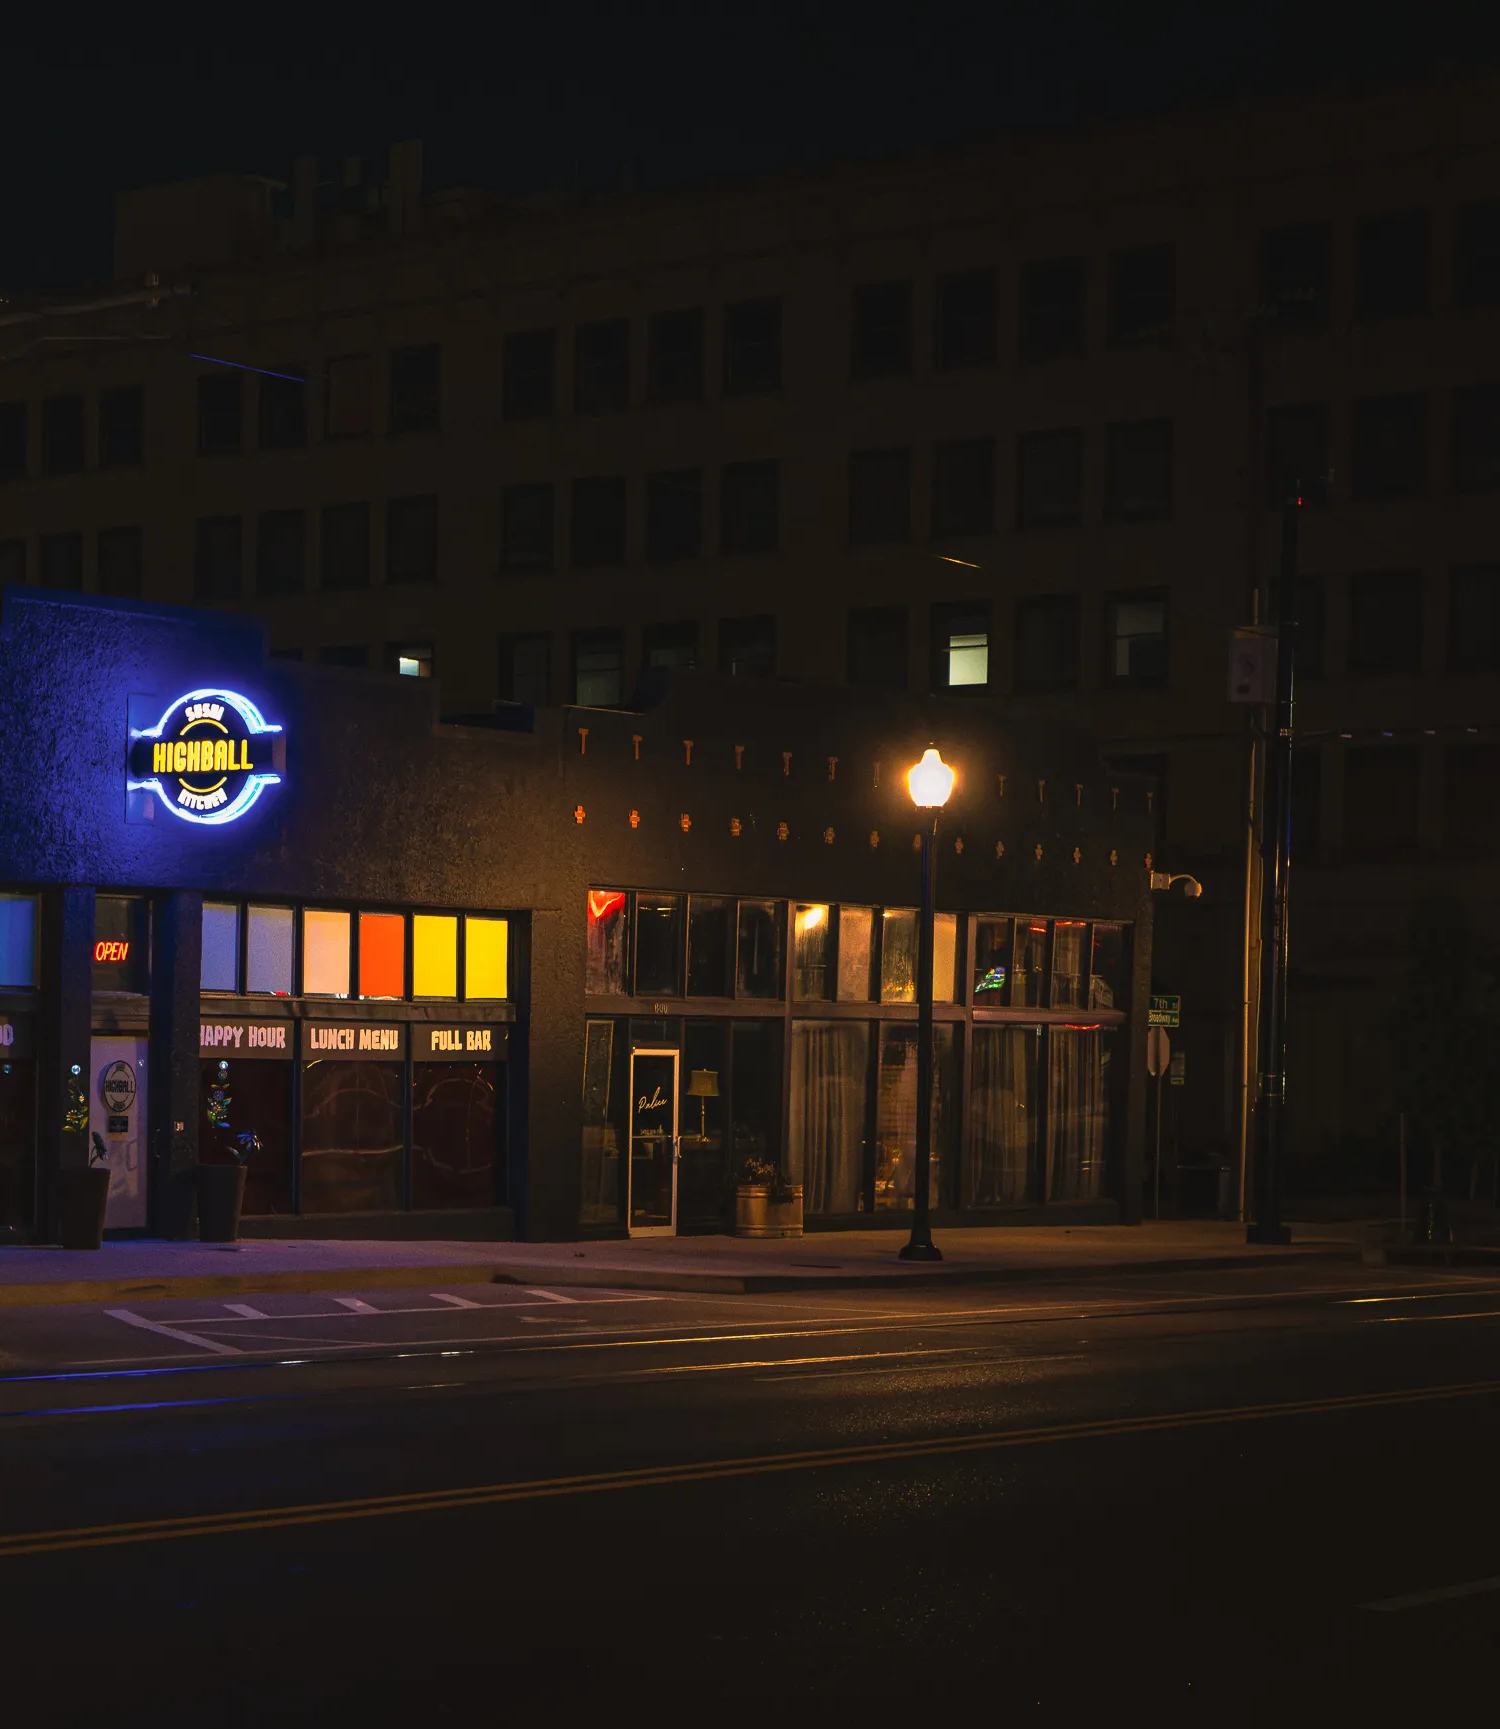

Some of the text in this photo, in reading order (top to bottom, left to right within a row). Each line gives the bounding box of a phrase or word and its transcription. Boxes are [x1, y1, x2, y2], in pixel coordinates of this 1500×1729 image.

[185, 703, 225, 722] SUSHI
[153, 740, 254, 773] HIGHBALL
[95, 941, 129, 961] OPEN
[1153, 998, 1168, 1009] 7th
[248, 1026, 286, 1049] HOUR
[310, 1027, 399, 1050] LUNCH MENU
[431, 1030, 491, 1051] FULL BAR
